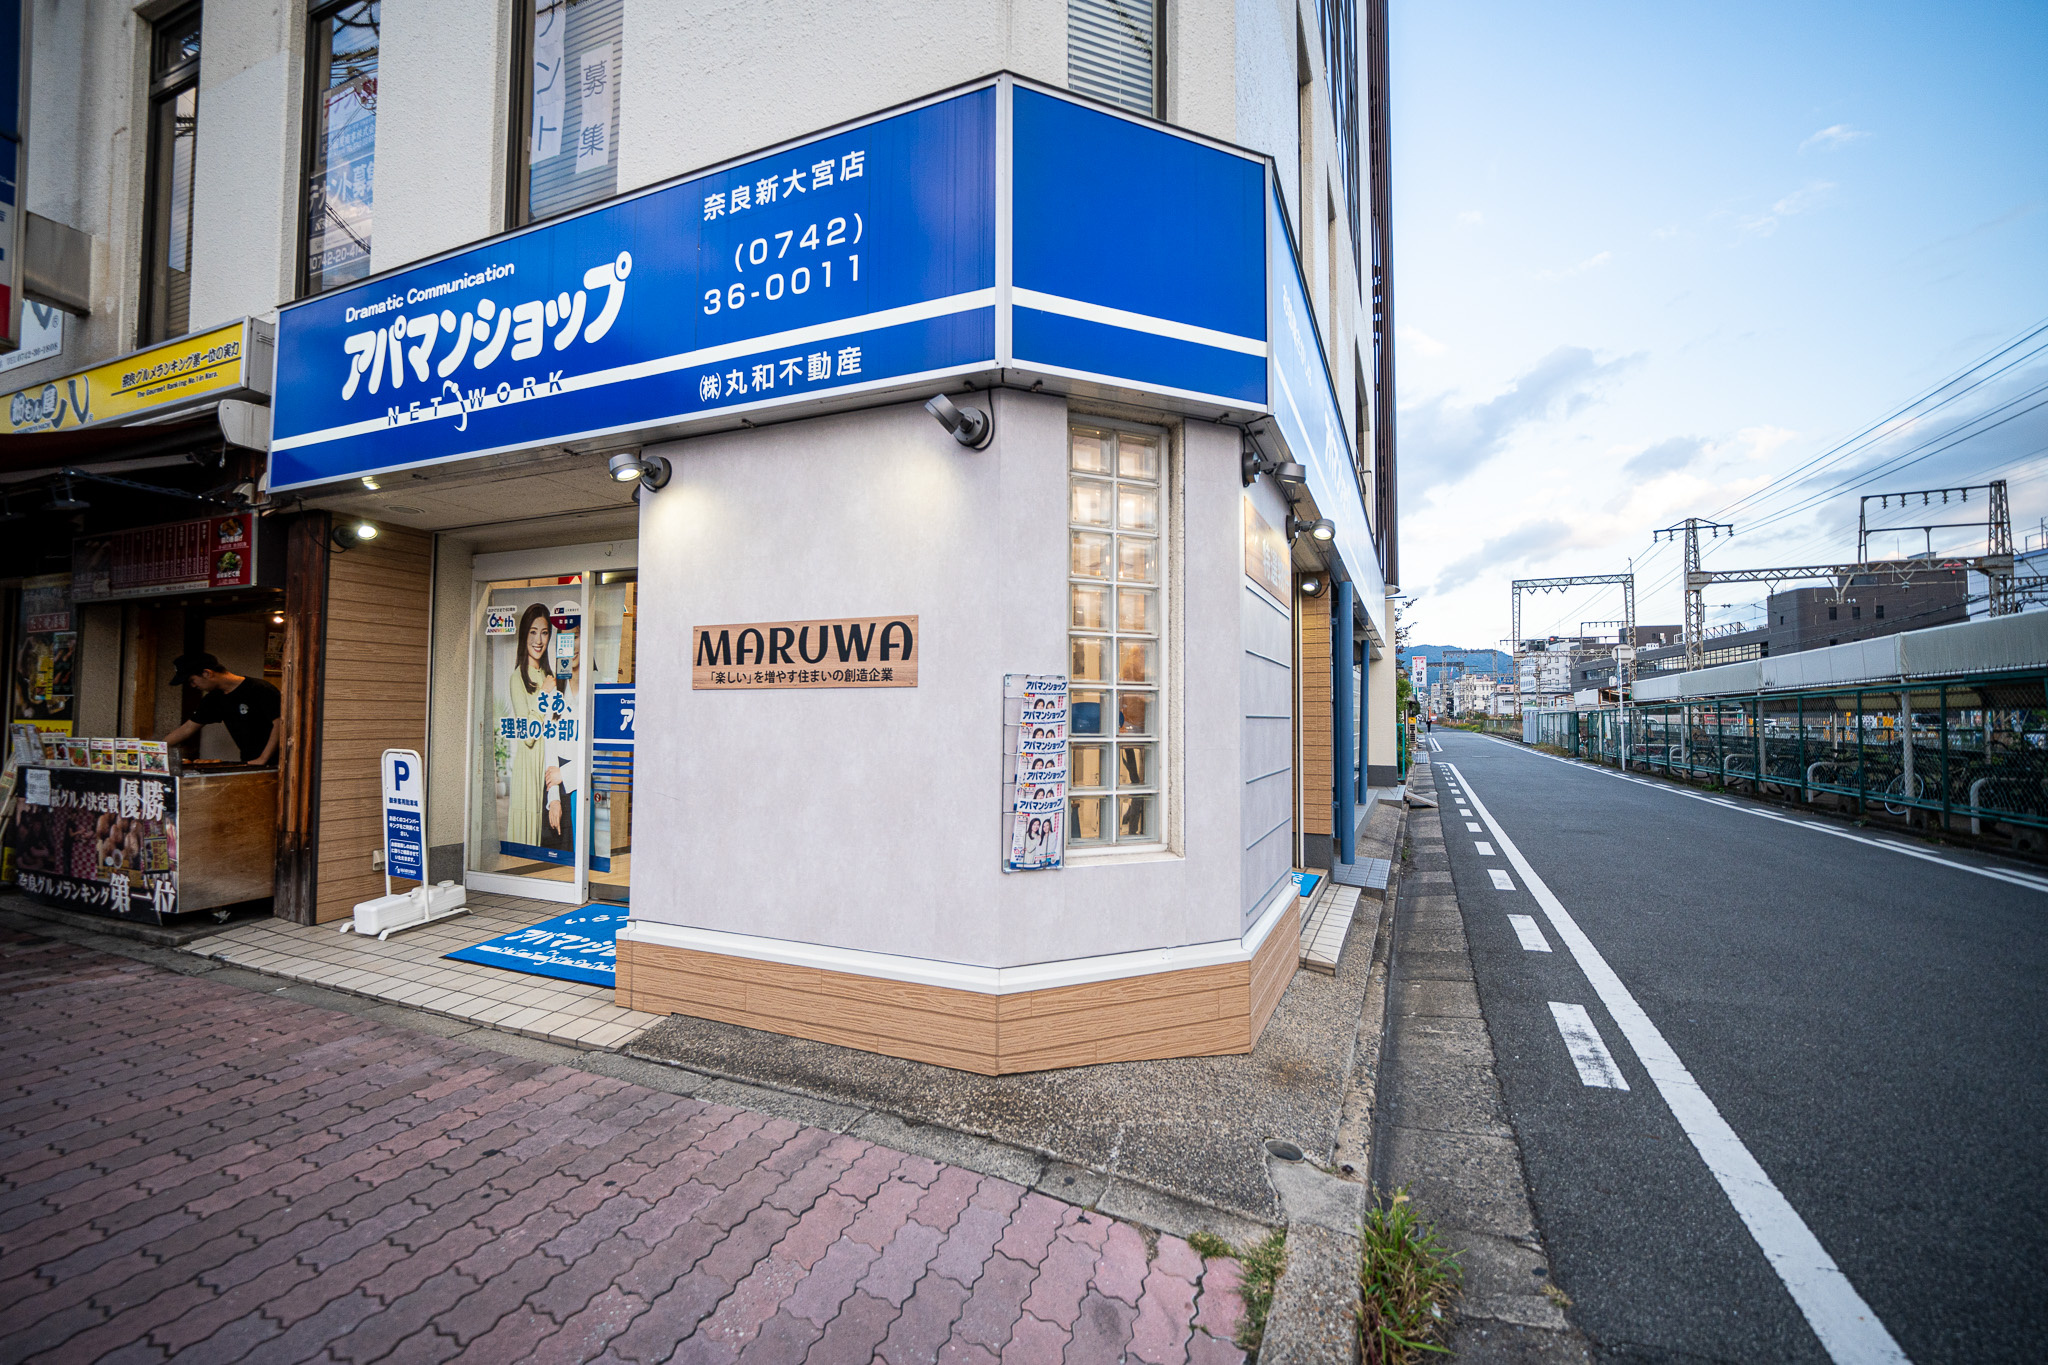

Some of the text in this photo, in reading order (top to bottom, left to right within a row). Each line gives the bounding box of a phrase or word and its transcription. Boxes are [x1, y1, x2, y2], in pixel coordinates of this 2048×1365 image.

[579, 60, 608, 158] 募集
[703, 150, 865, 222] 奈良新大宮店
[734, 213, 863, 272] (0742)
[345, 263, 515, 322] Dramatic Communication
[703, 254, 859, 315] 36-0011
[342, 250, 633, 401] アパマンショップ
[122, 341, 240, 388] 奈良グルメランキング第一位の実力
[696, 621, 914, 666] MARUWA
[710, 667, 894, 685] 「楽しい」を増やす住まいの創造企業
[1025, 681, 1067, 691] アパマンショップ
[538, 692, 572, 713] さあ、
[1022, 709, 1066, 720] アパマンショップ
[501, 718, 579, 741] 理想のお部
[1023, 740, 1066, 750] アパマンショップ
[394, 760, 410, 791] P
[1026, 770, 1066, 781] アパマンショップ
[1019, 798, 1063, 810] アパマンショップ
